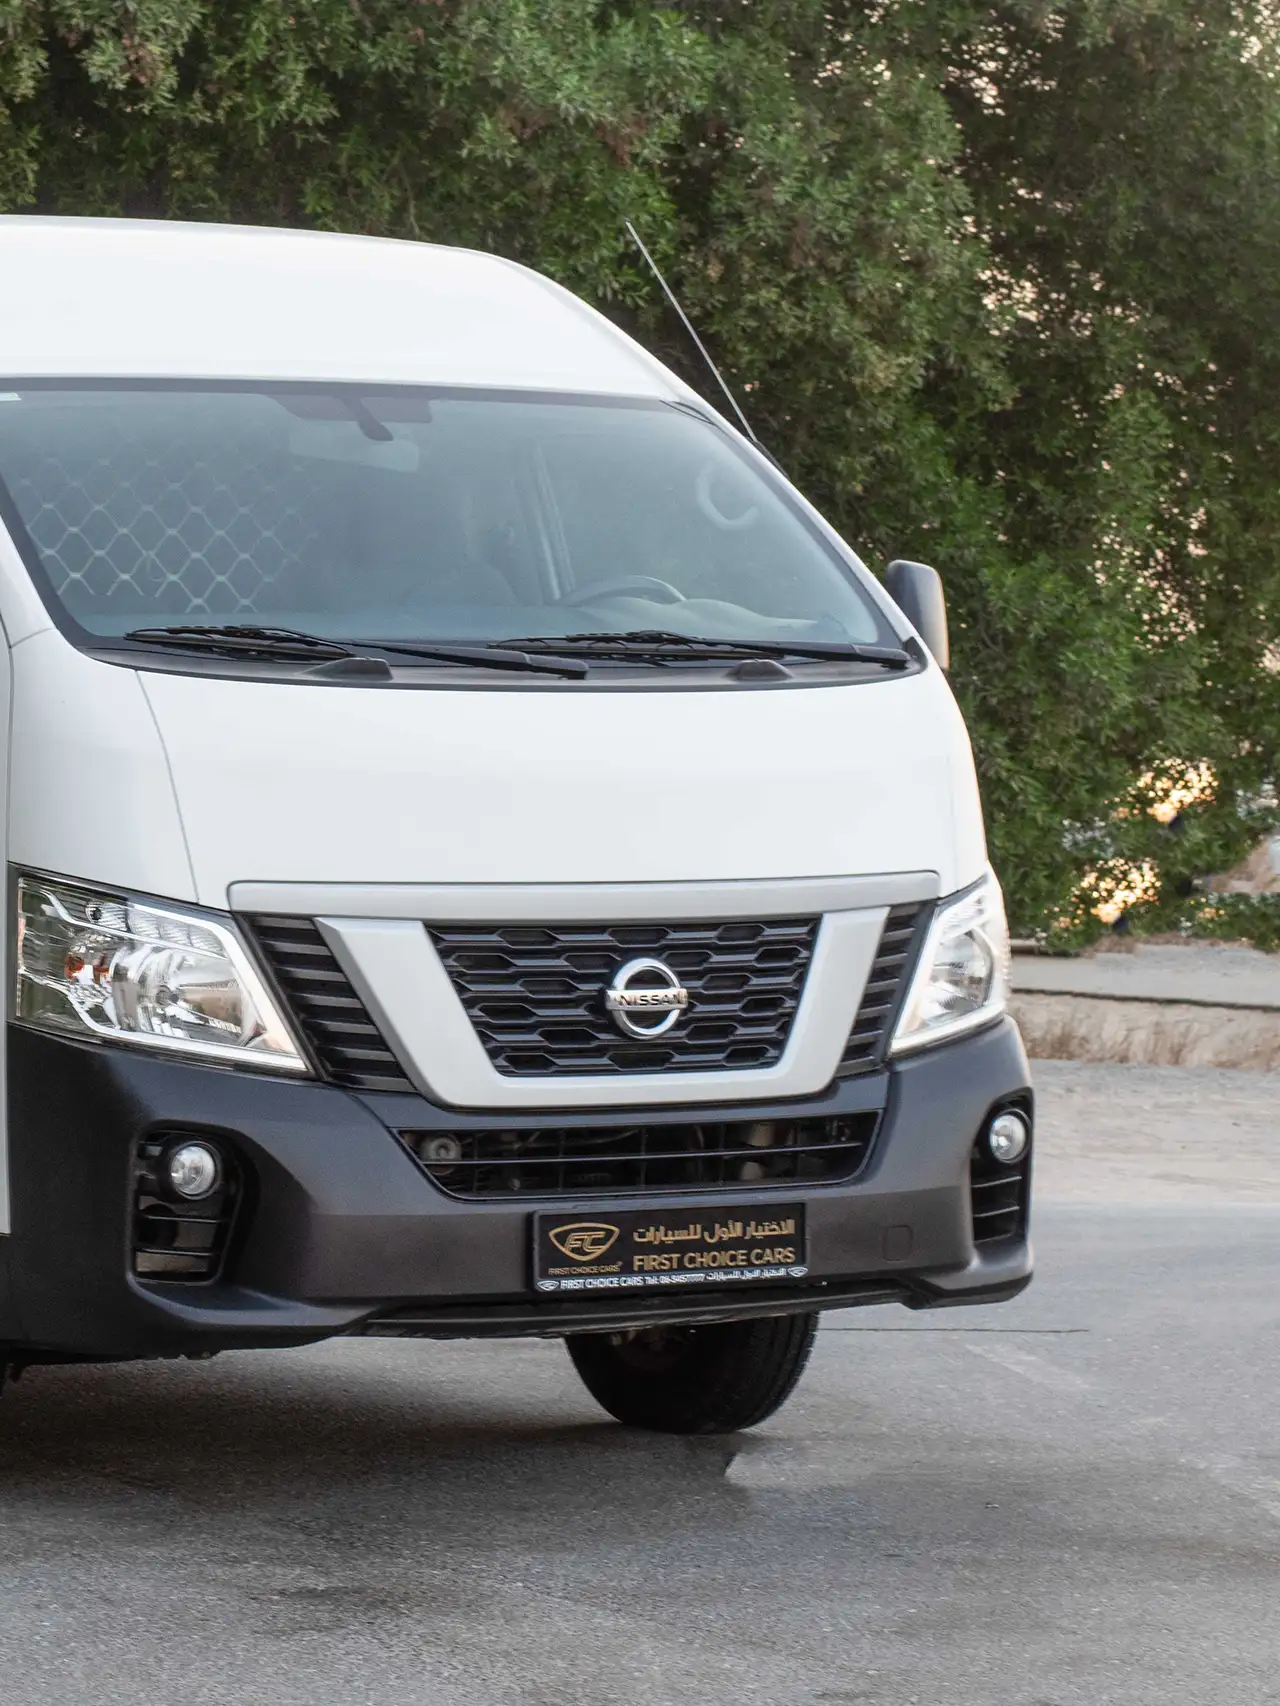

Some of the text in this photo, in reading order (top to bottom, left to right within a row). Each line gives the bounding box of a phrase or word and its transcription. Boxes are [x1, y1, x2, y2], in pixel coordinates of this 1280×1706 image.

[615, 992, 686, 1006] NISSAN
[632, 1224, 702, 1245] للسيارات
[632, 1247, 796, 1271] FIRST CHOICE CARS
[548, 1264, 620, 1276] FIRST CHOICE CARS
[560, 1279, 585, 1290] FIRST
[585, 1277, 620, 1288] CHOICE
[620, 1276, 644, 1287] CARS
